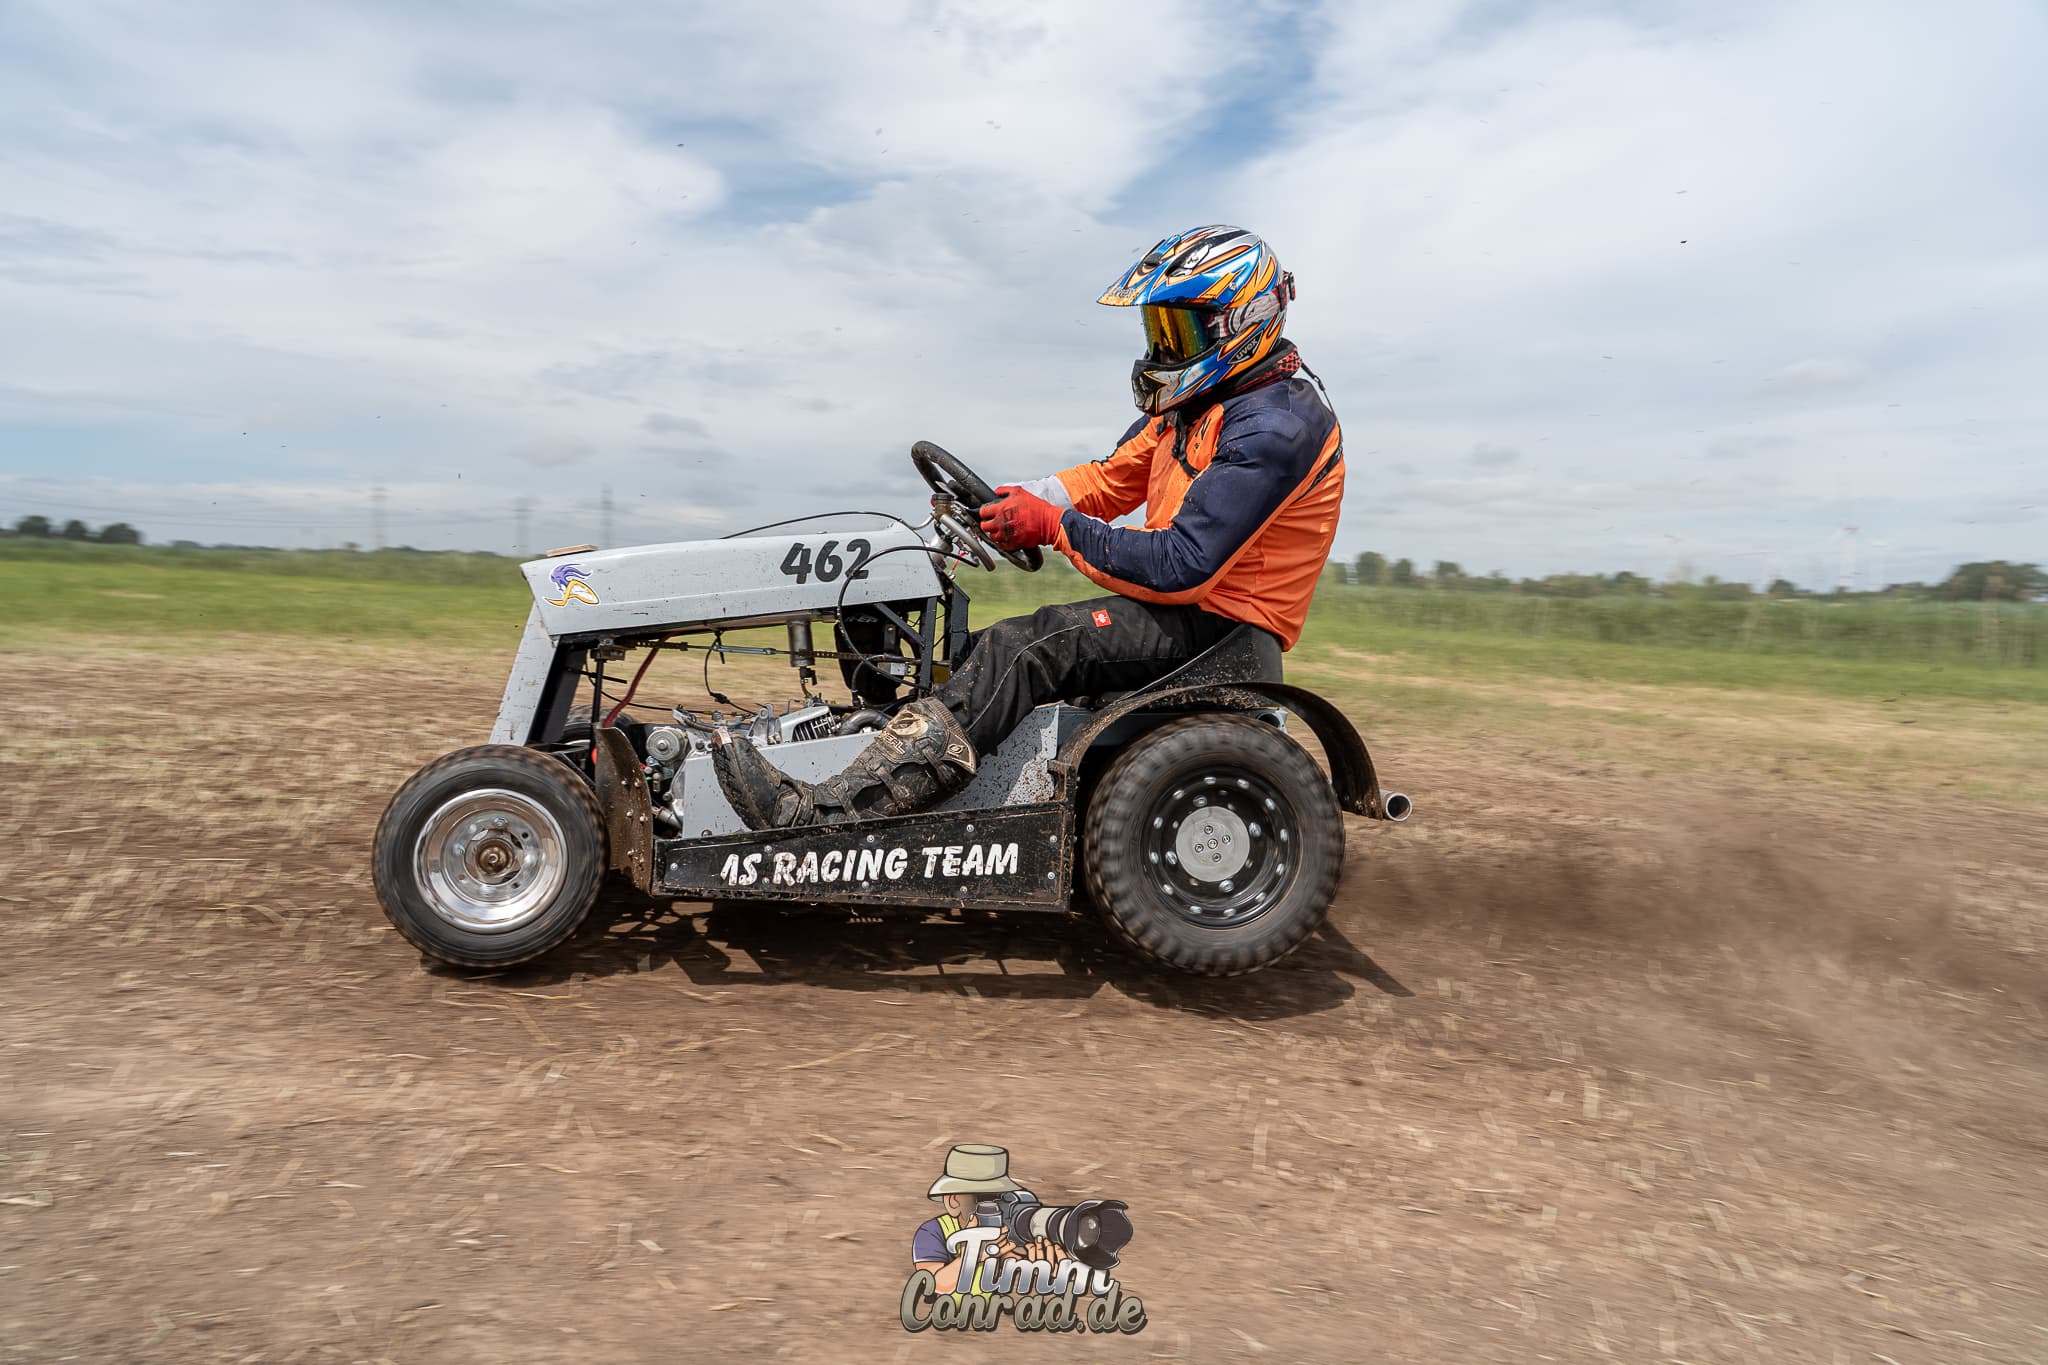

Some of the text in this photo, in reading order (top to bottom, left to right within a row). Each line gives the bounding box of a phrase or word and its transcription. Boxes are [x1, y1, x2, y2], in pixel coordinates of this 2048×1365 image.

[780, 538, 871, 584] 462
[772, 848, 908, 886] RACING
[921, 842, 1019, 878] TEAM
